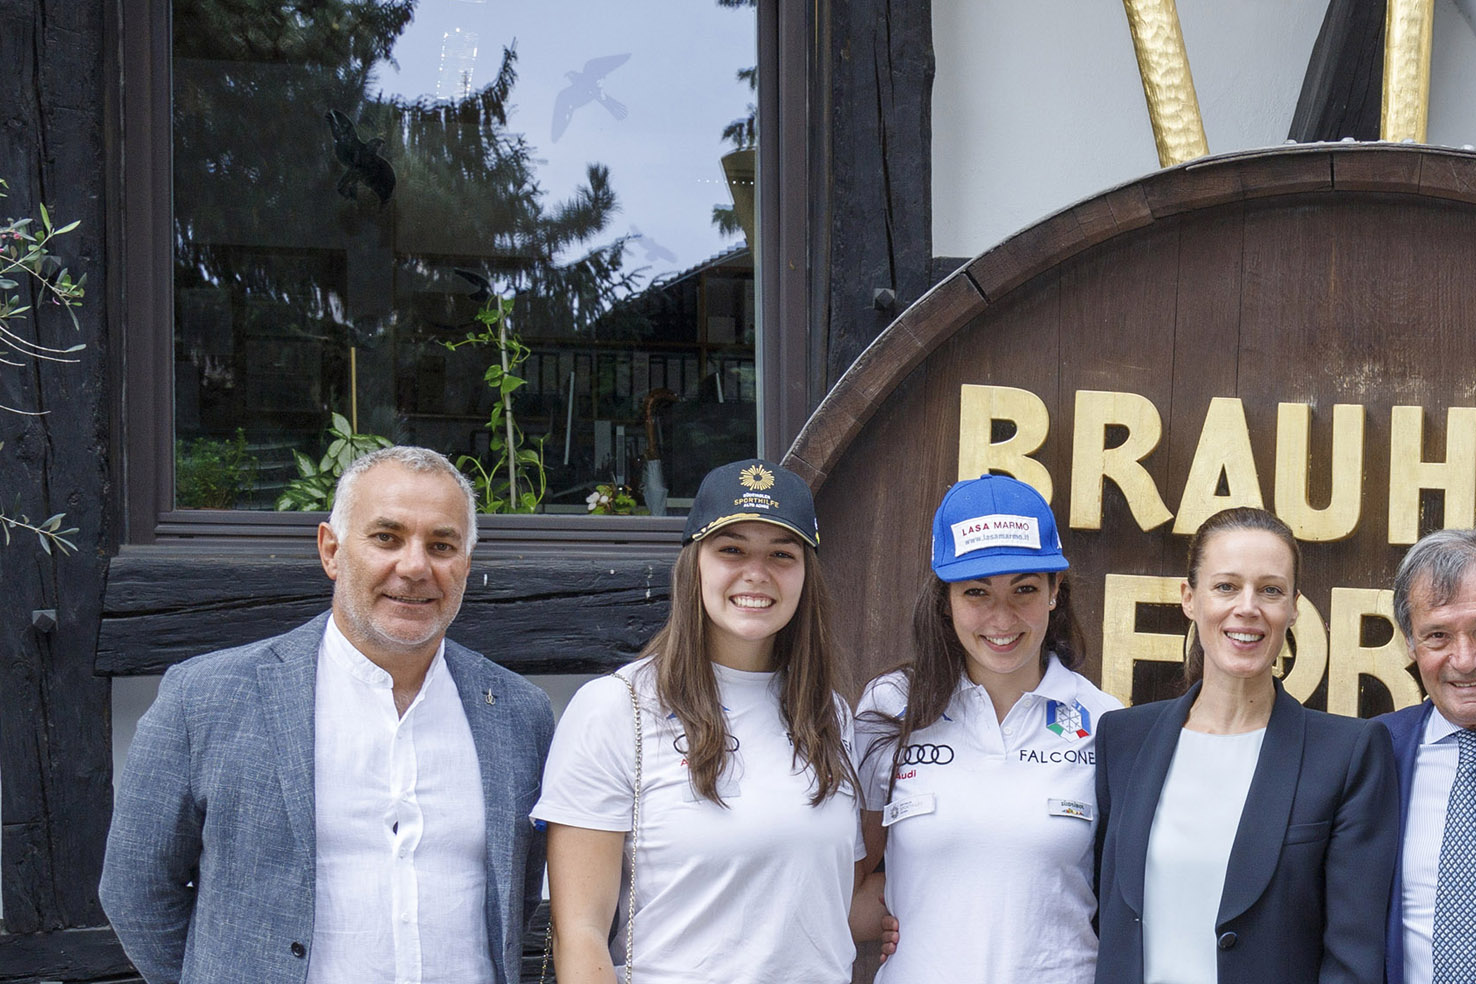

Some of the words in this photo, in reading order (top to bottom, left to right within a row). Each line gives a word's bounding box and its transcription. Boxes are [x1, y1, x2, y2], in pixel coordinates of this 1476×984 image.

[734, 498, 779, 508] SPORTHILFE
[962, 522, 990, 536] LASA
[993, 521, 1030, 531] MARMO
[896, 769, 917, 780] Audi
